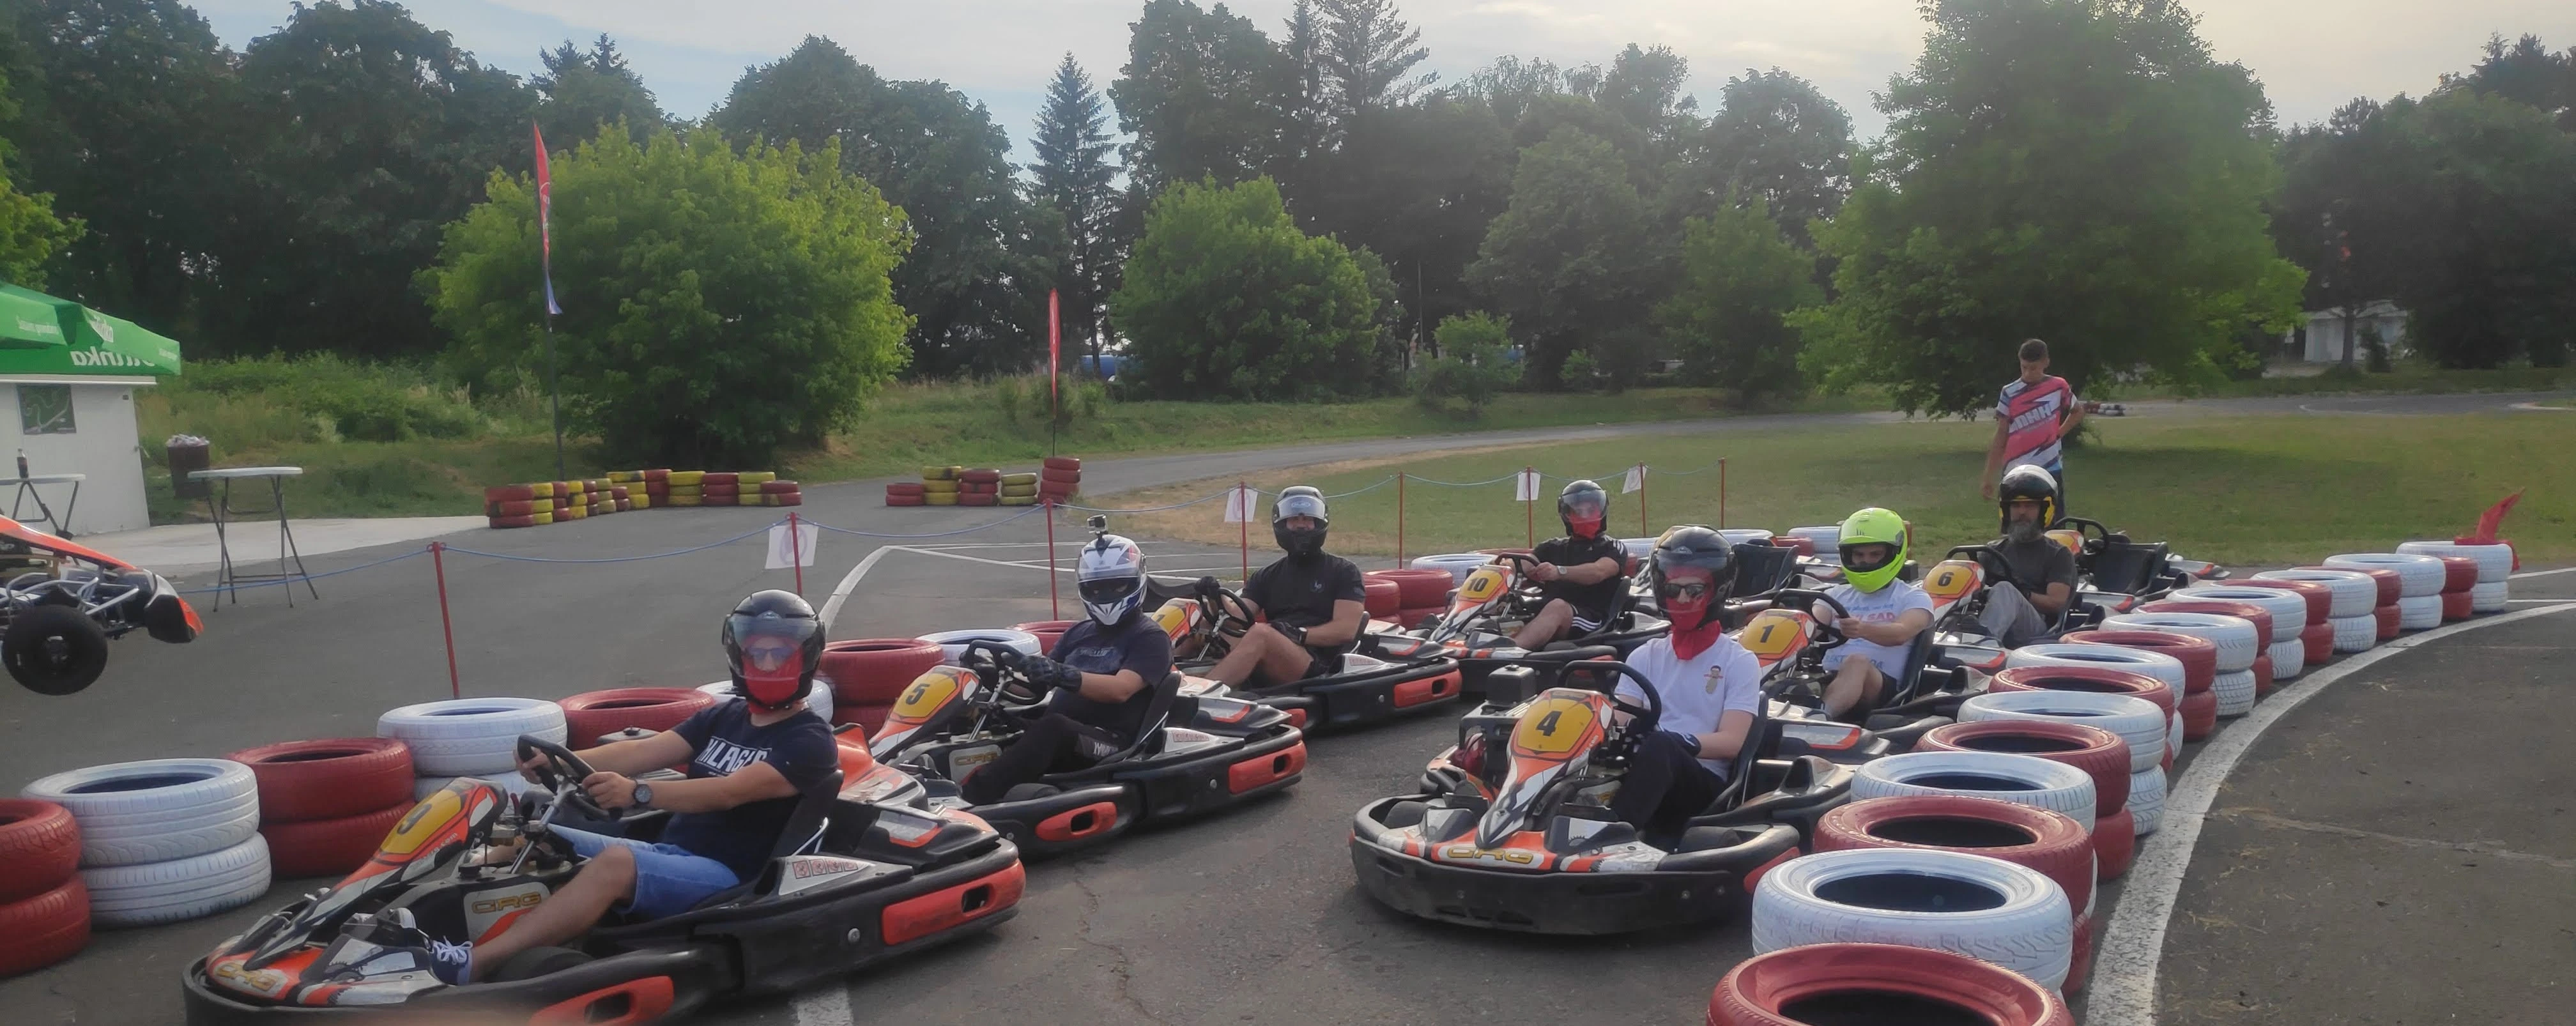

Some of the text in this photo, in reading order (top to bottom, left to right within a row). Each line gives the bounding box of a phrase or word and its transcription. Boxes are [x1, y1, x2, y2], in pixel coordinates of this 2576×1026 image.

[1467, 577, 1489, 592] 10
[1938, 572, 1954, 586] 6
[1759, 624, 1775, 643] 1
[905, 683, 931, 705] 5
[1535, 710, 1563, 737] 4
[471, 891, 542, 914] CRG
